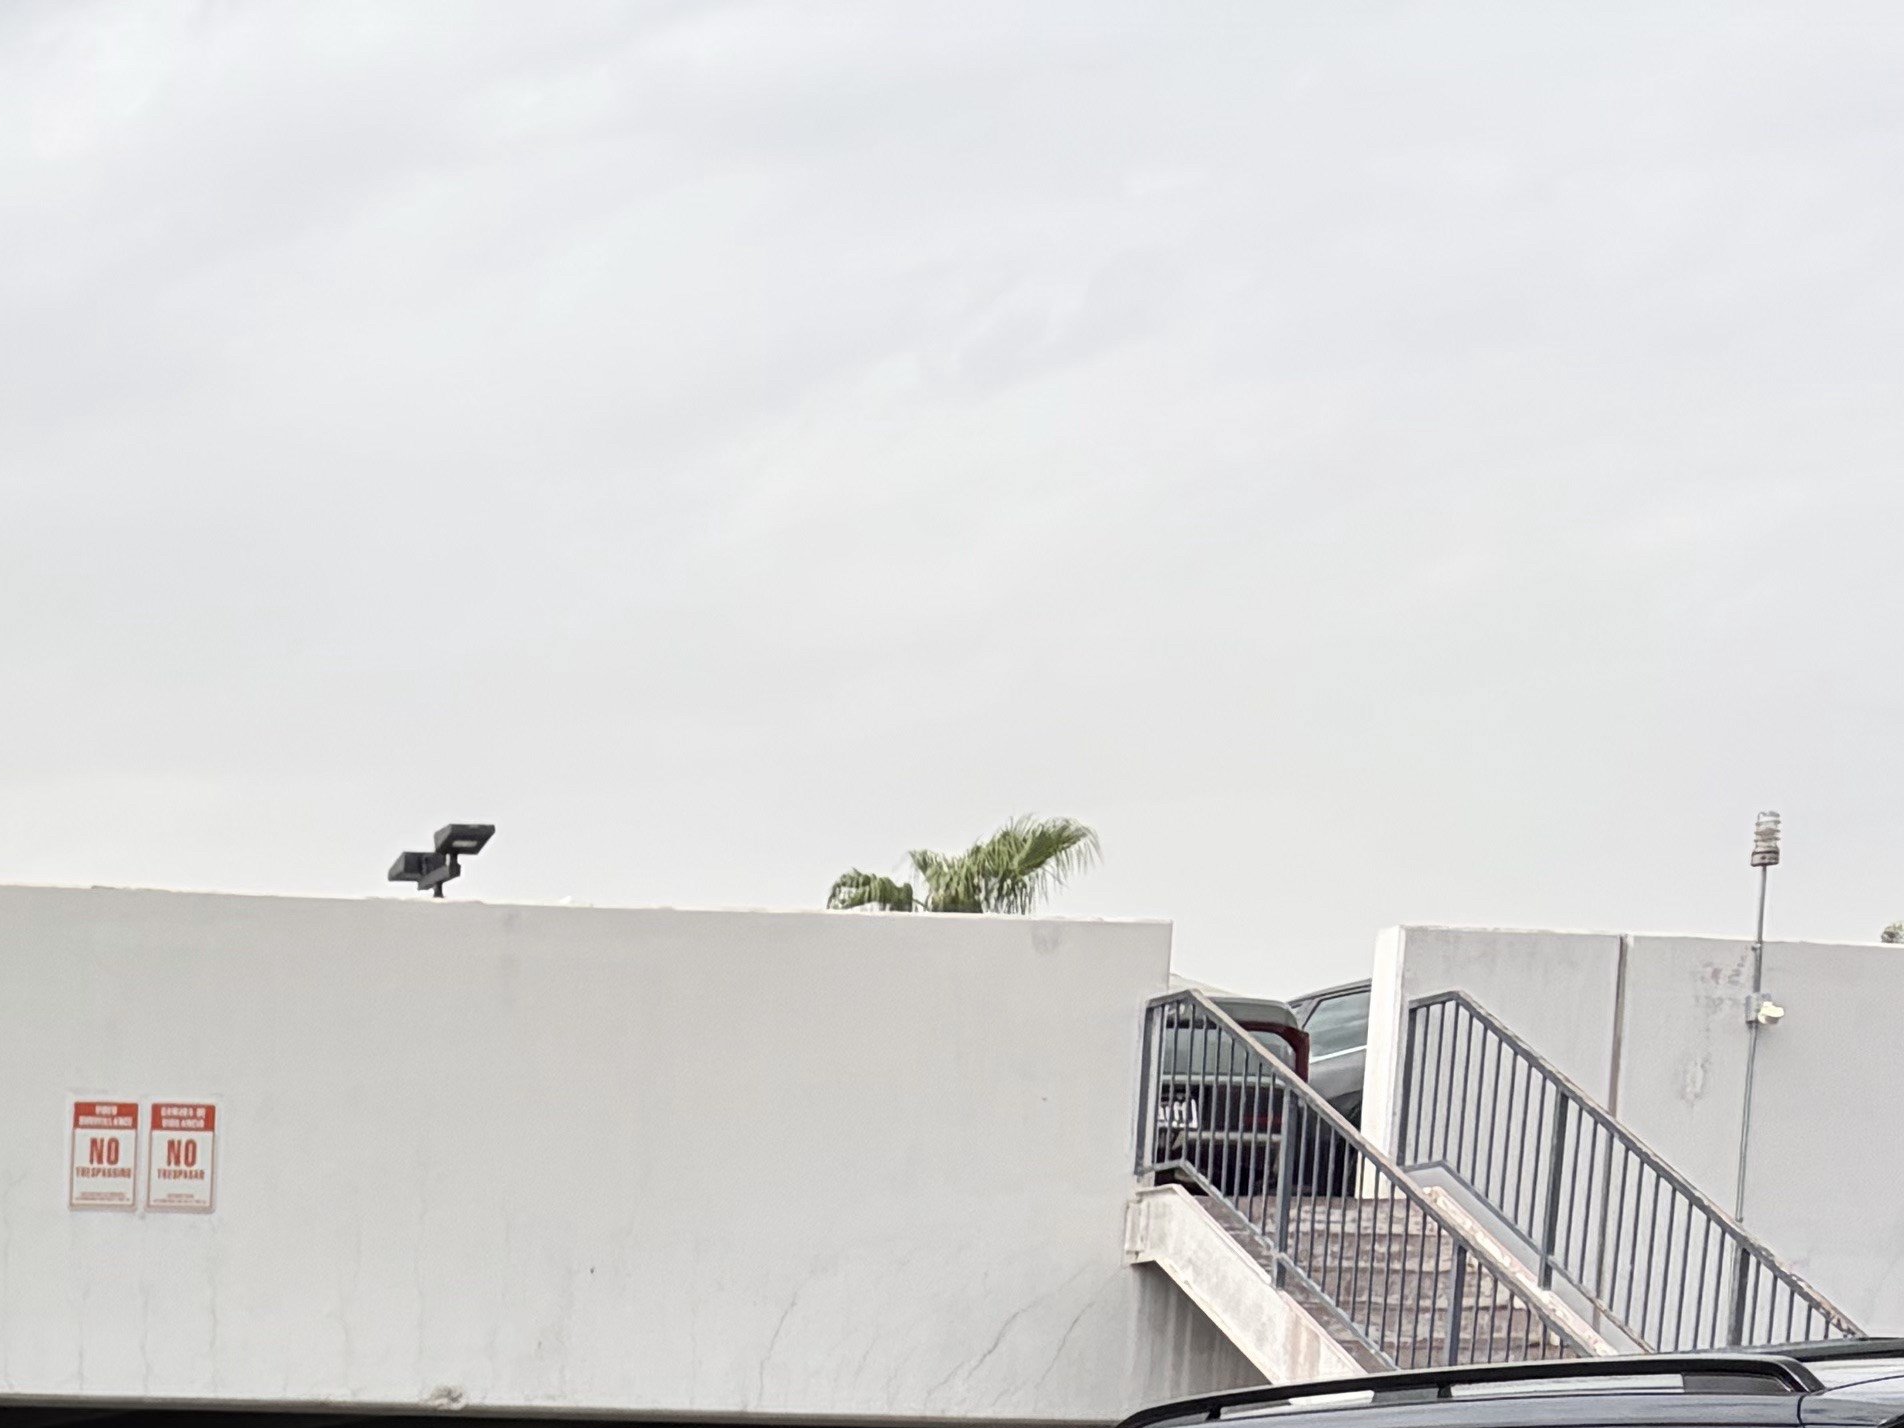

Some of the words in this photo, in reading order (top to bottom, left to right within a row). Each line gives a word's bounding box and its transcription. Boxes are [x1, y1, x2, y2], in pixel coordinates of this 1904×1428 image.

[89, 1136, 120, 1166] NO
[166, 1138, 198, 1168] NO
[75, 1166, 133, 1179] TRESPASSING
